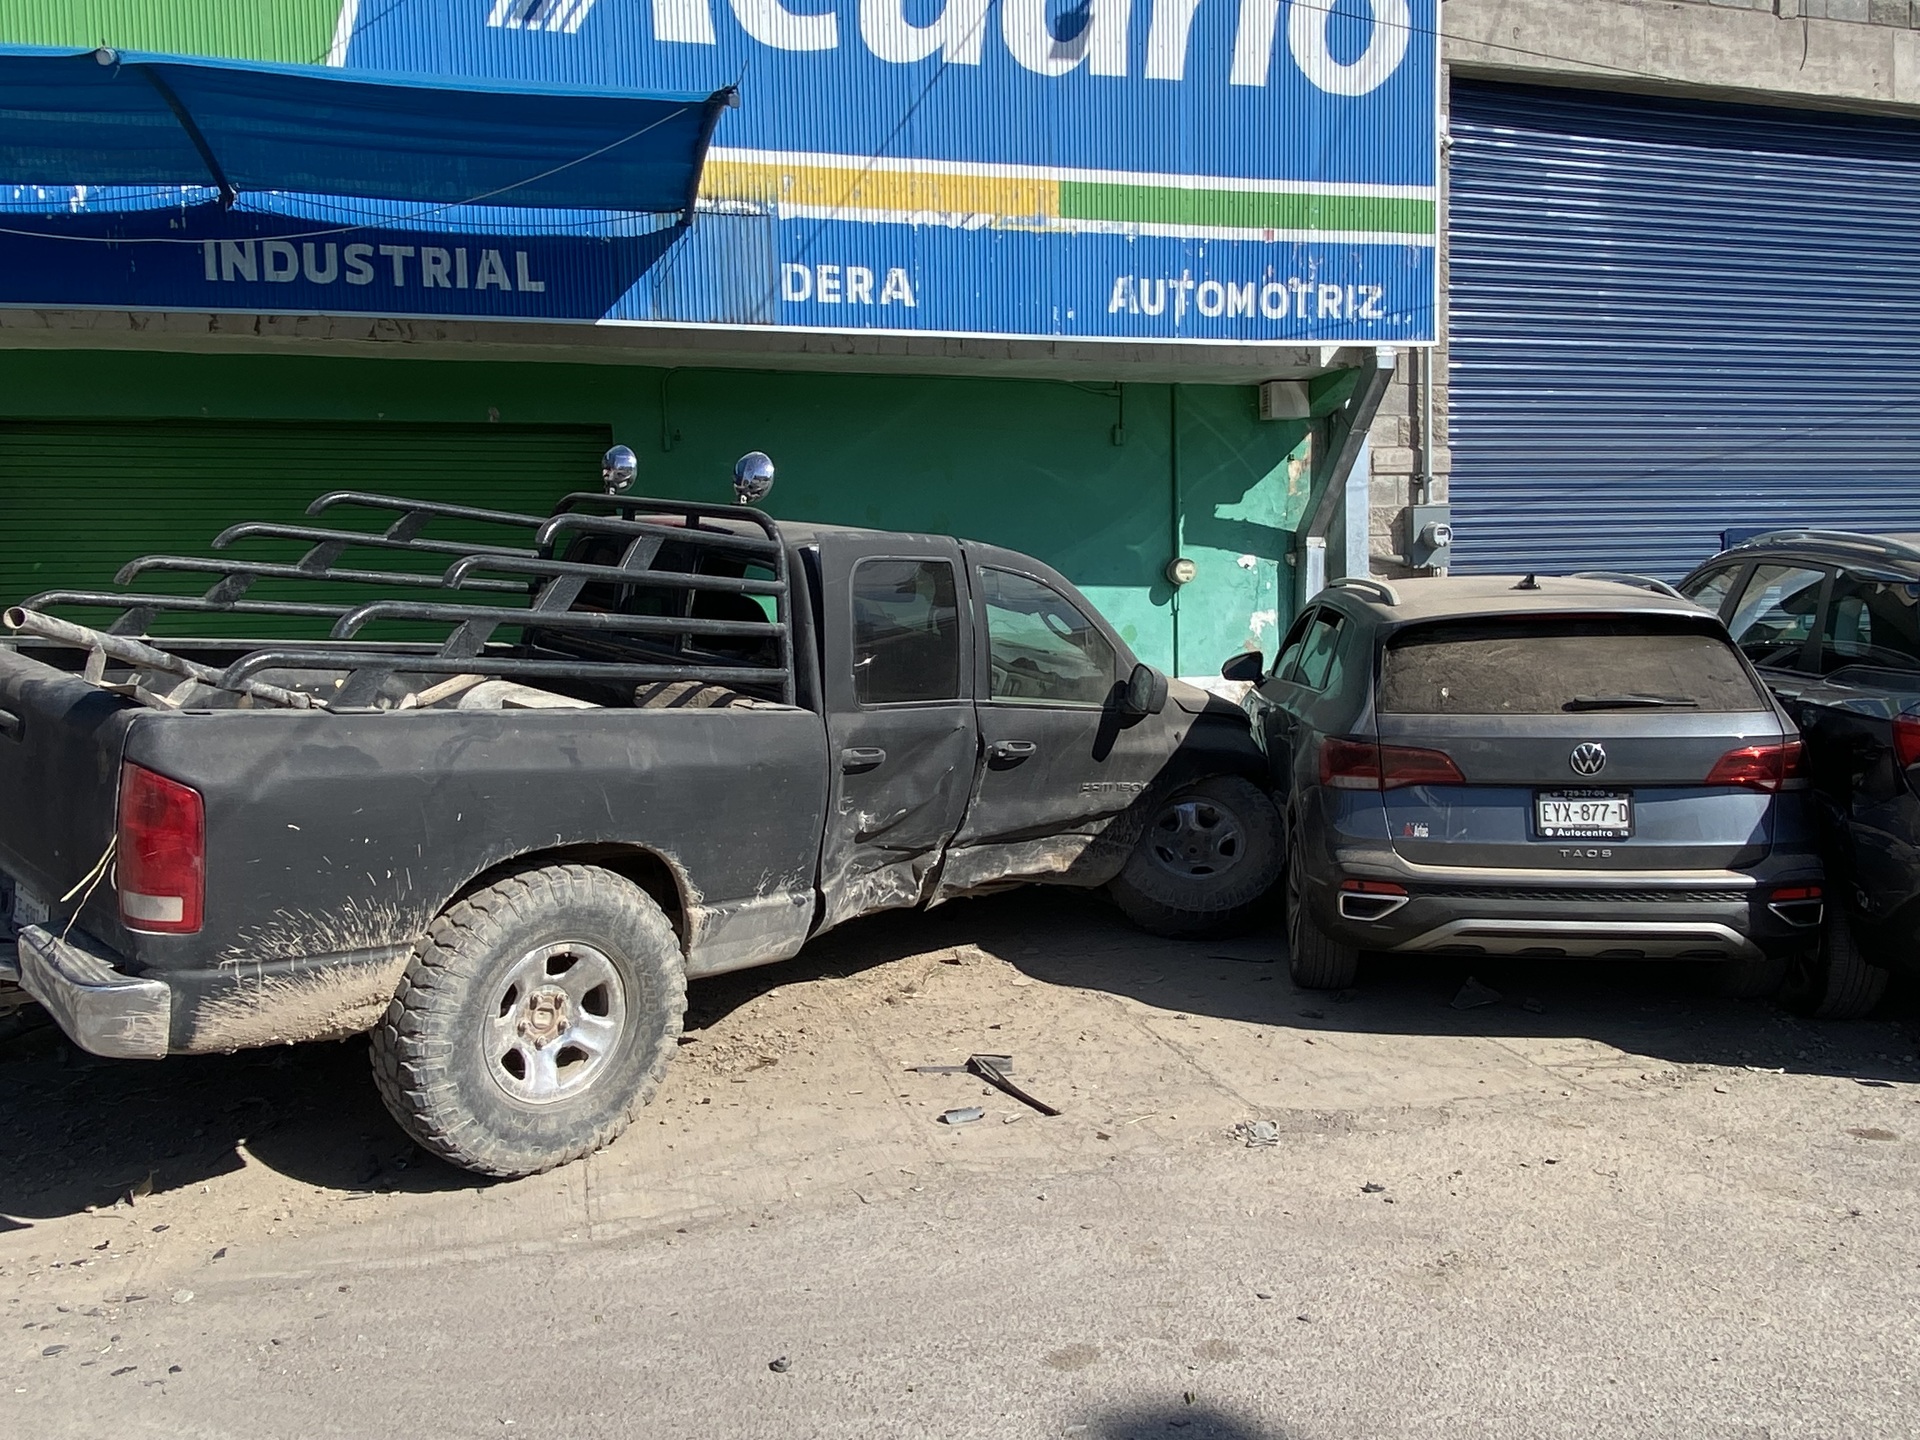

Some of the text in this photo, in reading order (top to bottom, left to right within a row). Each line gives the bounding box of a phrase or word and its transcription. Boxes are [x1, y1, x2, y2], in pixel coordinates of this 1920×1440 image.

[204, 240, 545, 292] INDUSTRIAL
[781, 262, 915, 307] DERA
[1108, 275, 1384, 320] AUTOMOTRIZ
[1542, 803, 1628, 822] EYX-877-D
[1556, 828, 1614, 837] Autocentro
[1559, 849, 1612, 858] TAOS
